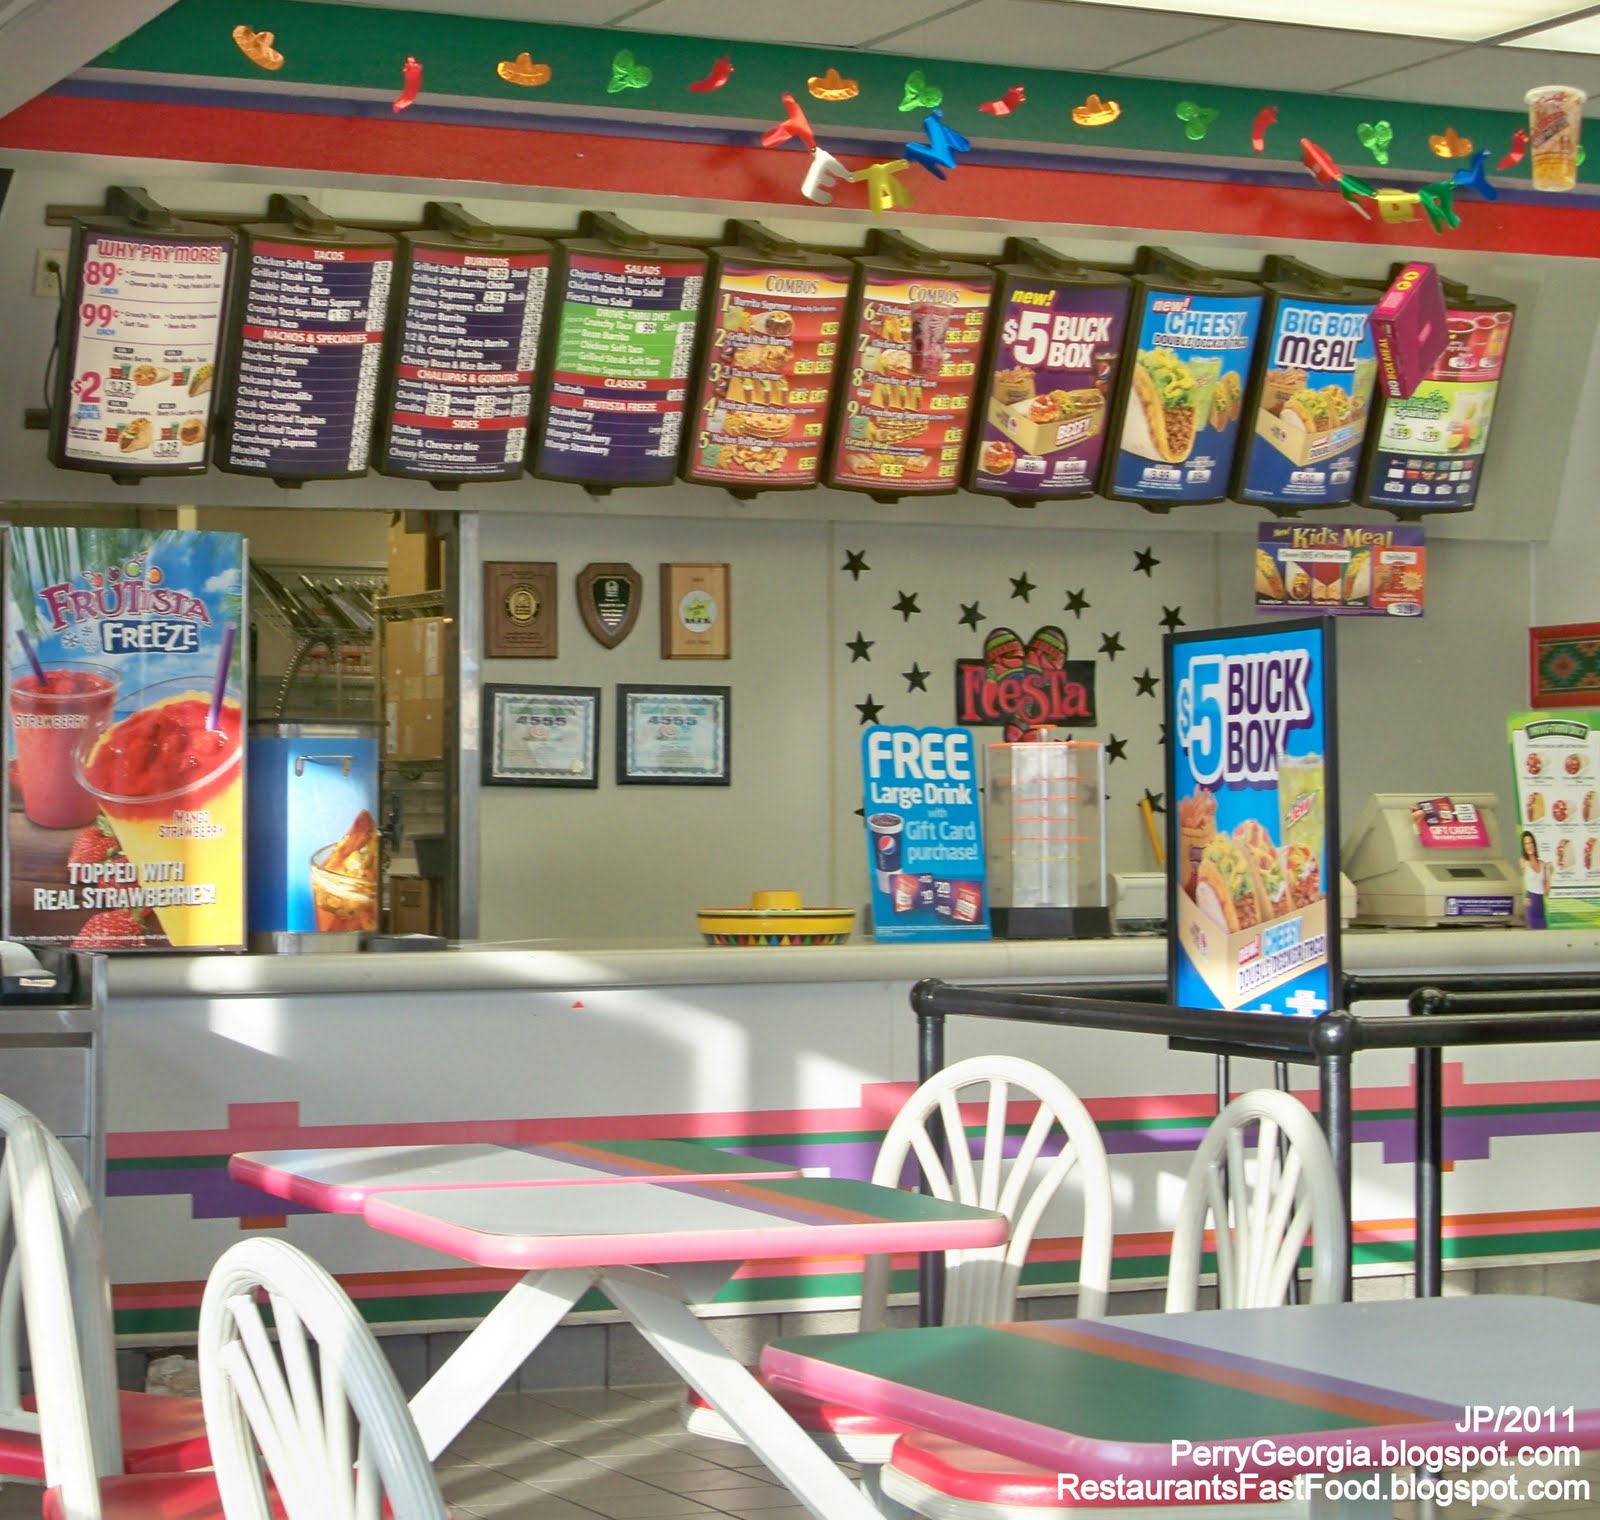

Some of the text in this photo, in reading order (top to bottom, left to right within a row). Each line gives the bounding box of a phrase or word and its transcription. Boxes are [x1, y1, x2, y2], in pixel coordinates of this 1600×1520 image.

[97, 240, 139, 259] WHY
[141, 244, 174, 262] PAY
[313, 250, 345, 260] TACOS
[253, 256, 324, 271] Chicken Soft Taco
[413, 261, 439, 273] Grilled
[461, 266, 487, 277] Burrito
[464, 256, 510, 267] BURRITOS
[624, 264, 661, 275] SALADS
[251, 268, 324, 283] Grilled Steak Taco
[604, 273, 626, 284] Steak
[627, 275, 644, 285] Taco
[644, 276, 666, 286] Salad
[568, 280, 664, 298] Chicken Ranch Taco Salad
[408, 297, 438, 308] Burrito
[475, 302, 504, 313] Chicken
[591, 295, 609, 306] Taco
[609, 297, 632, 307] Salad
[721, 293, 731, 313] 1
[1011, 290, 1056, 307] new!
[1152, 296, 1191, 314] new!
[247, 303, 277, 317] Crunchy
[295, 308, 328, 320] Supreme
[407, 308, 467, 323] 7-Layer Burrito
[863, 301, 875, 321] 6
[1165, 310, 1248, 338] CHEESY
[1284, 308, 1367, 339] BIG BOX
[243, 339, 273, 350] Nachos
[263, 330, 368, 343] NACHOS & SPECIALTIES
[715, 328, 726, 348] 2
[857, 333, 870, 353] 7
[1002, 310, 1112, 365] $5 BUCK
[1153, 333, 1195, 348] DOUBLE
[242, 350, 309, 366] Nachos Supreme
[1047, 342, 1095, 368] BOX
[1276, 336, 1357, 370] MEAL
[709, 363, 721, 382] 3
[1378, 338, 1401, 396] BIG BOX MEAL
[417, 369, 520, 384] CHALUPAS & GORDITAS
[604, 378, 647, 389] CLASSICS
[853, 367, 865, 387] 8
[72, 371, 101, 404] $2
[238, 387, 313, 401] Chicken Quesadilla
[236, 398, 302, 412] Steak Quesadilla
[549, 406, 594, 421] Strawberry
[583, 399, 658, 412] FRUTISTA FREEZE
[703, 397, 717, 418] 4
[847, 400, 859, 419] 9
[452, 419, 480, 429] SIDES
[282, 437, 318, 449] Supreme
[425, 439, 452, 450] Cheese
[463, 442, 480, 451] Rice
[699, 431, 710, 449] 5
[1292, 527, 1339, 548] Kid's
[1342, 528, 1394, 549] Meal
[40, 580, 213, 633] FRUTISTA
[103, 621, 198, 653] FREEZE
[15, 714, 89, 729] STRAWBERRY
[515, 715, 567, 727] 4555
[648, 715, 698, 727] 4555
[1177, 655, 1308, 784] $5 BUCK
[868, 730, 971, 781] FREE
[1227, 719, 1285, 776] BOX
[871, 782, 973, 809] Large Drink
[174, 810, 209, 824] MANGO
[928, 808, 948, 818] with
[159, 824, 224, 839] STRAWBERRY
[905, 821, 975, 841] Gift Card
[907, 842, 978, 865] purchase!
[69, 861, 184, 885] TOPPED WITH
[34, 883, 216, 911] REAL STRAWBERRIES!
